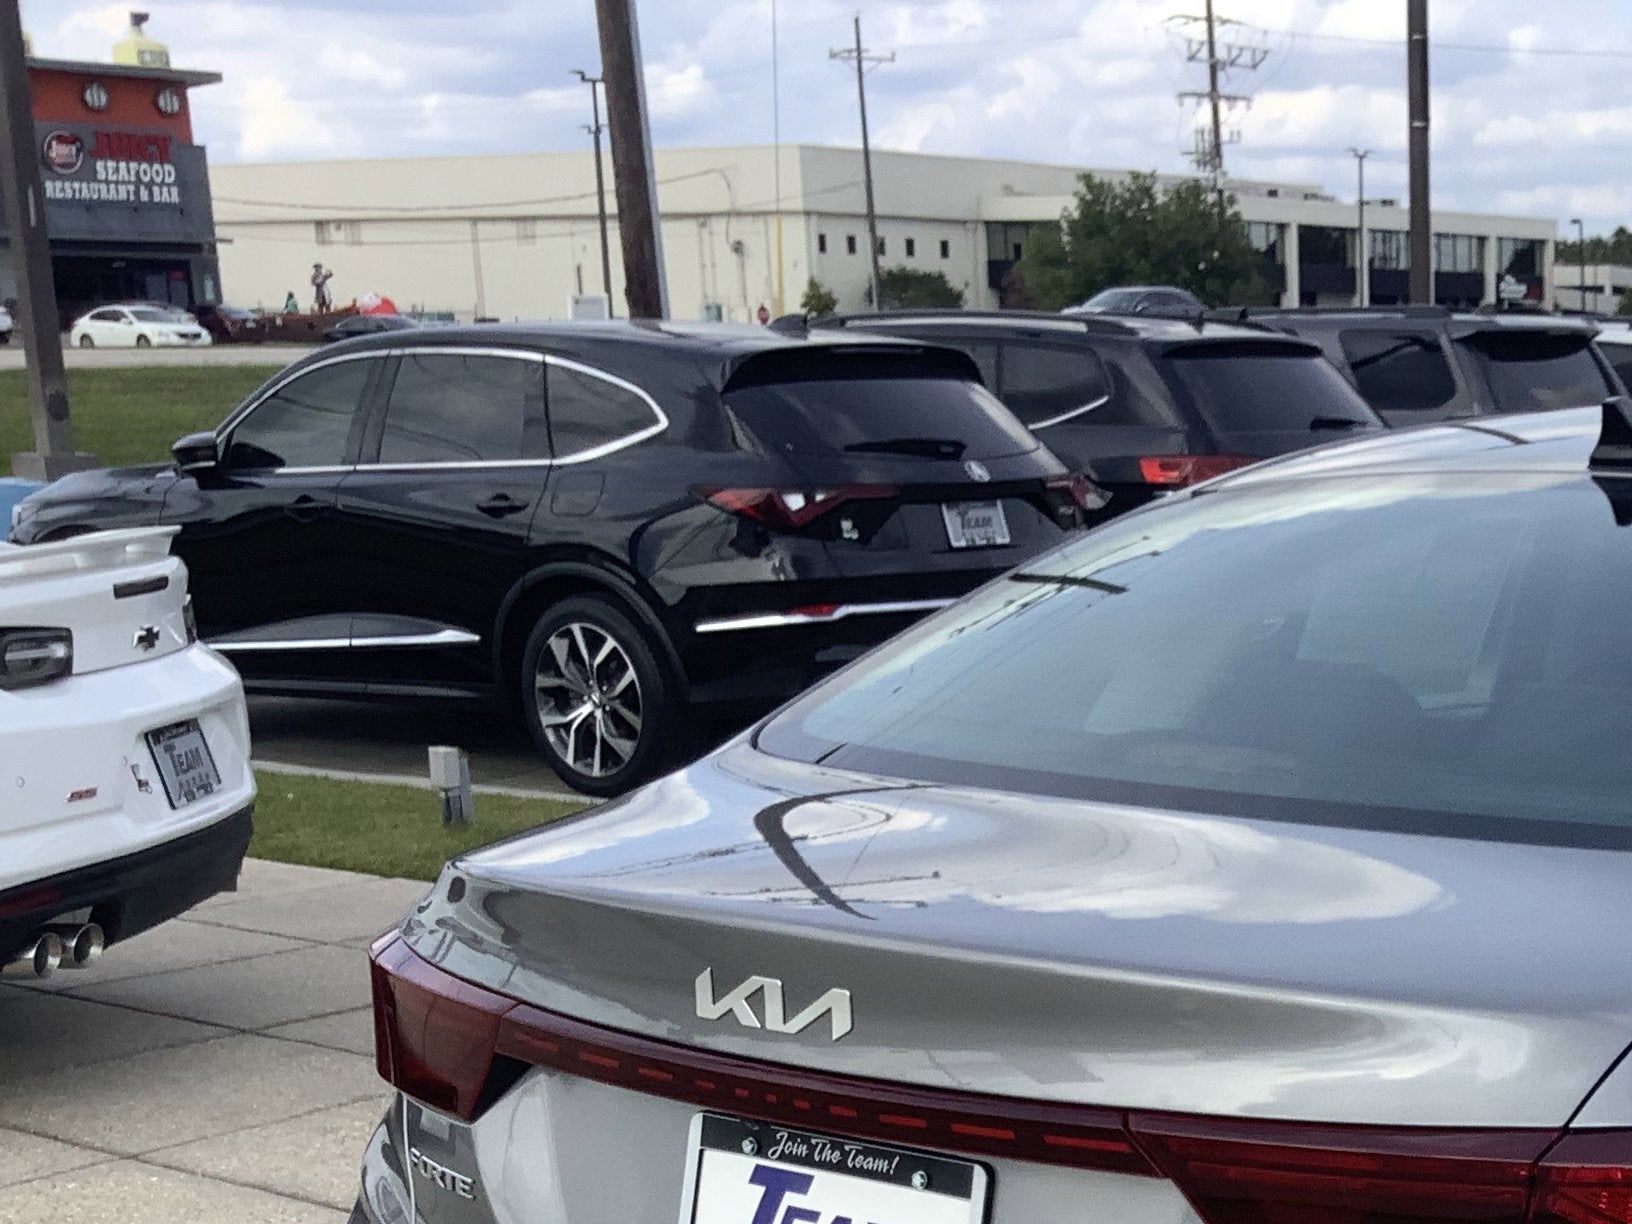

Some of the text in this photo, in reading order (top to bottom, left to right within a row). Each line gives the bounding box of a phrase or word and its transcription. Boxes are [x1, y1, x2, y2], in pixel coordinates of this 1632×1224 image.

[96, 160, 176, 184] SEAFOOD
[45, 180, 179, 203] RESTAURANT & BAR
[163, 742, 204, 777] TEAM
[695, 967, 853, 1042] KIA
[767, 1132, 900, 1175] Join The Team!
